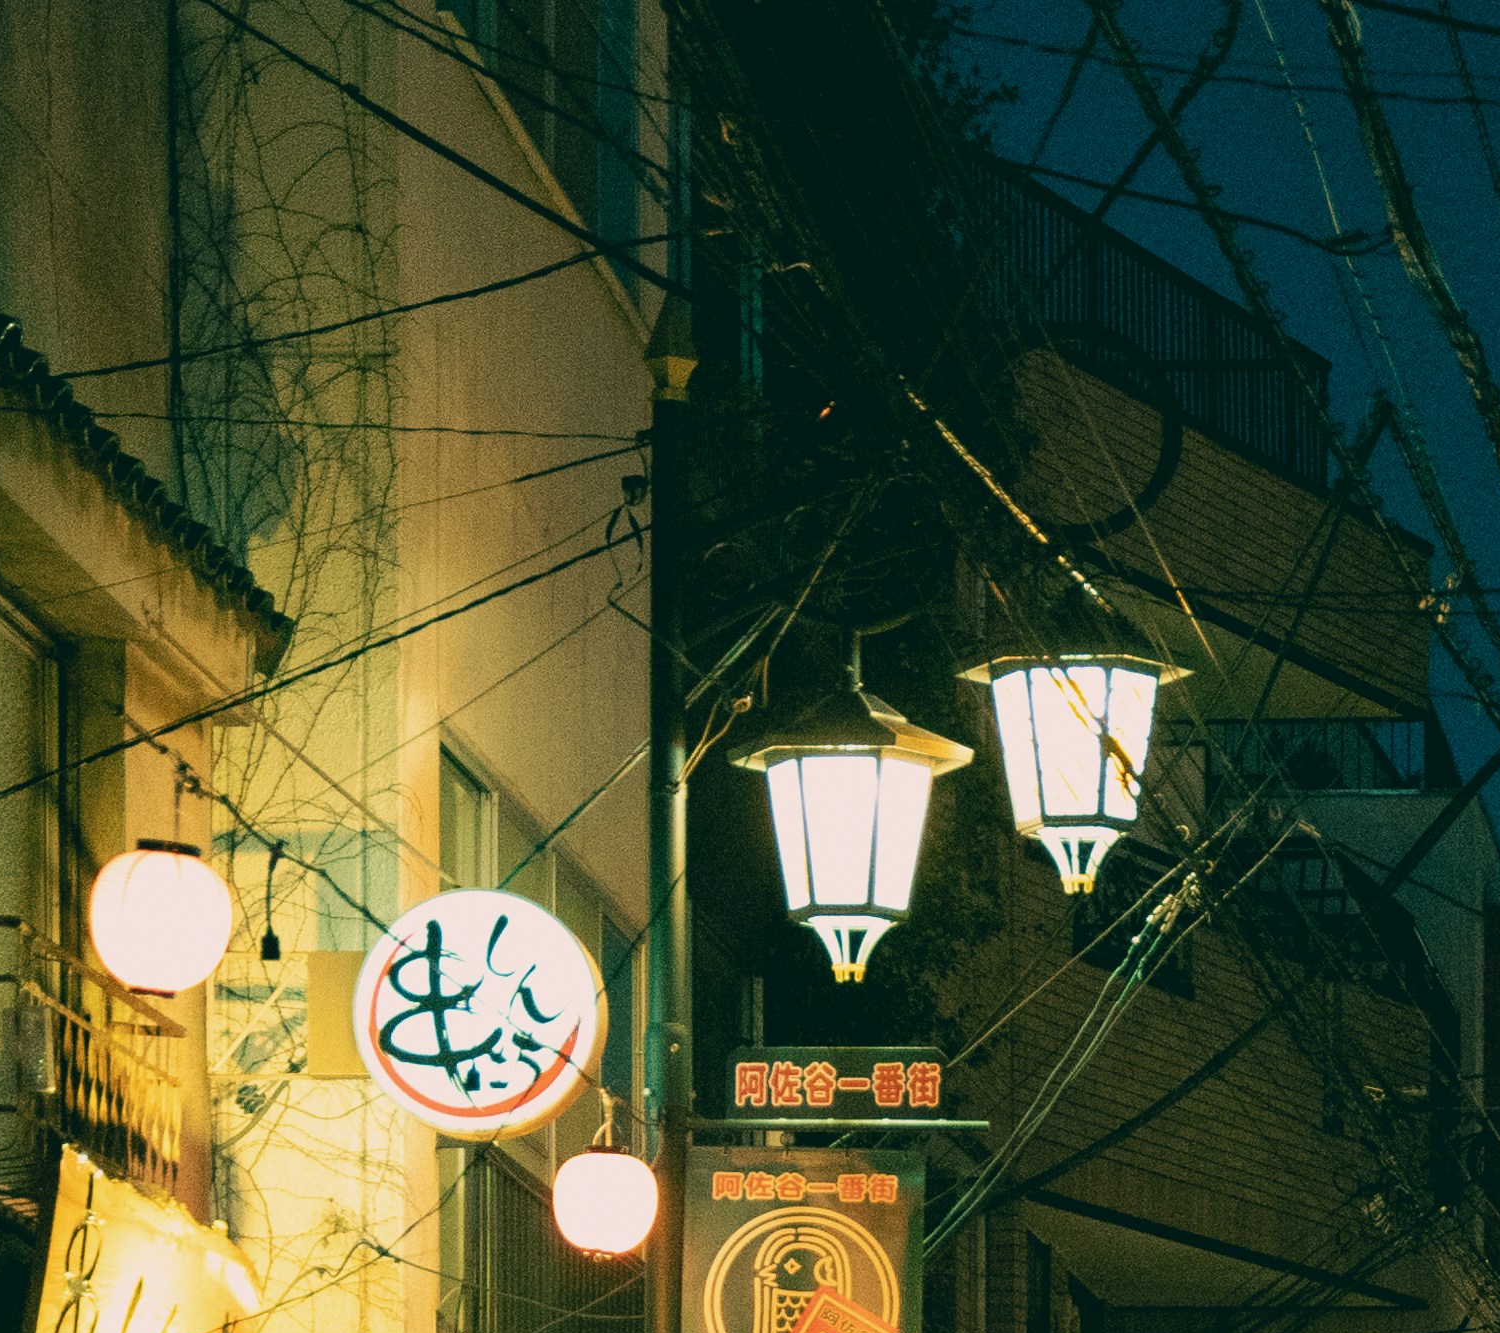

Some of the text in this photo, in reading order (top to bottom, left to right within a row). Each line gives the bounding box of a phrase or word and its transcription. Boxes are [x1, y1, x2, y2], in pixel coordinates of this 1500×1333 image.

[735, 1061, 941, 1108] 阿佐谷一番街
[711, 1171, 899, 1203] 阿佐谷一番街
